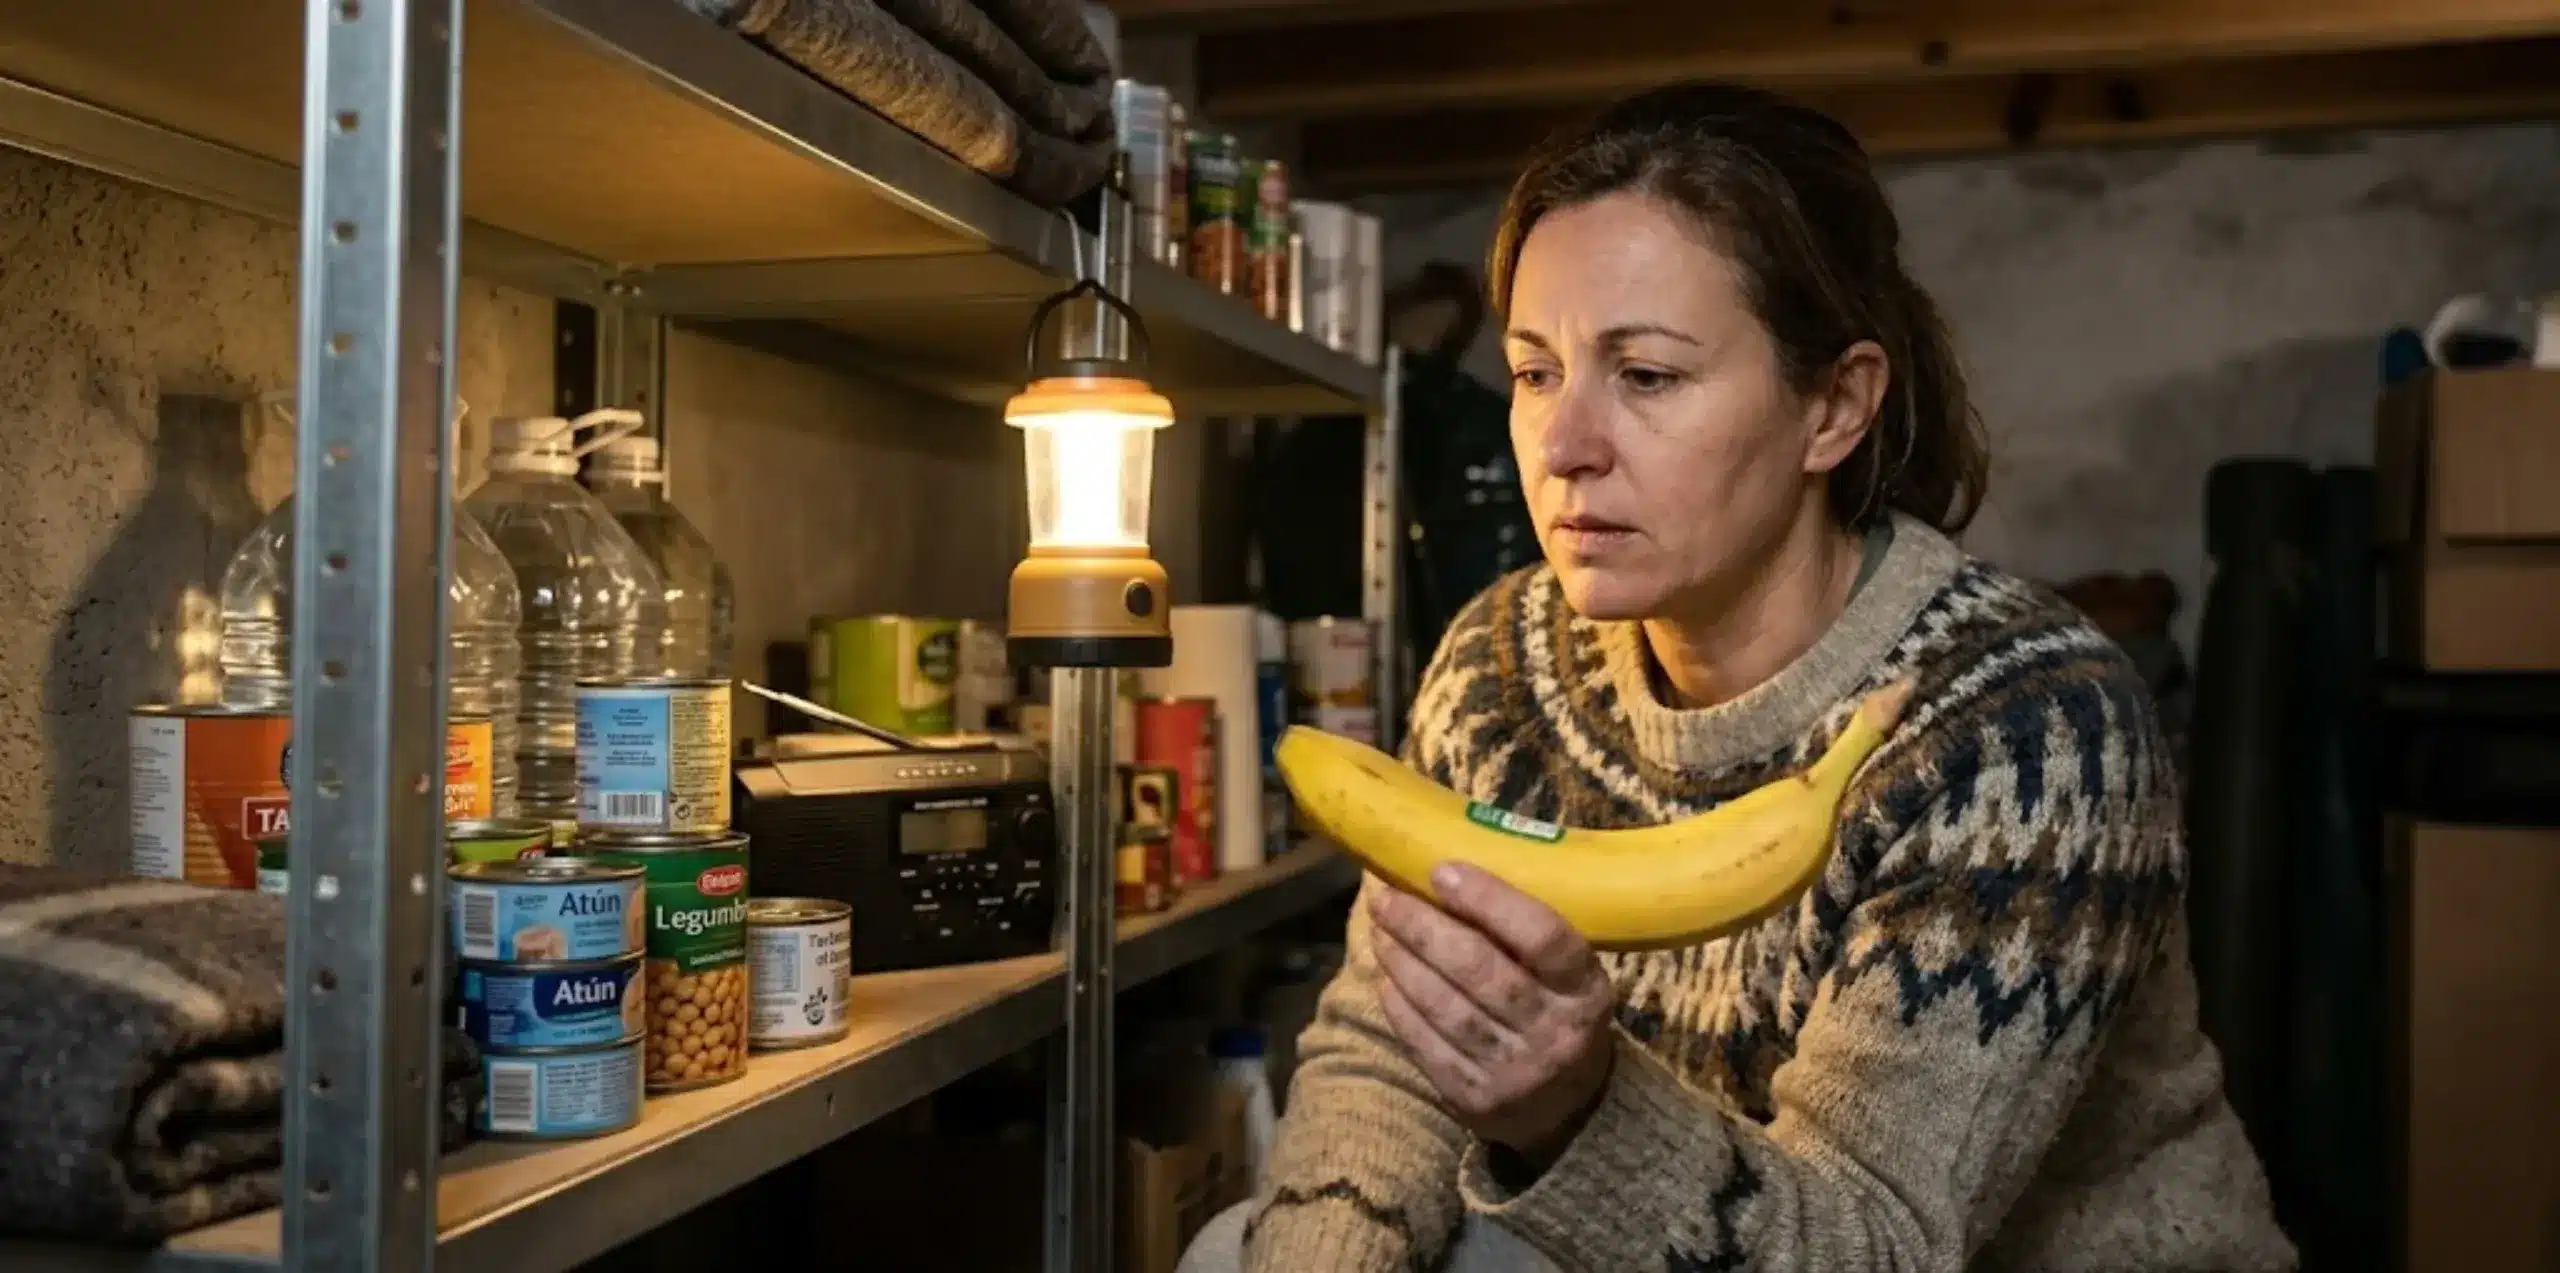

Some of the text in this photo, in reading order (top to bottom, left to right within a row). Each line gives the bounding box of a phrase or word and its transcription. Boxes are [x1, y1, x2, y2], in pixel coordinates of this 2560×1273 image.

[255, 808, 291, 832] TA
[559, 888, 621, 916] Atún
[656, 897, 747, 935] Legumb
[553, 977, 616, 1006] Atún
